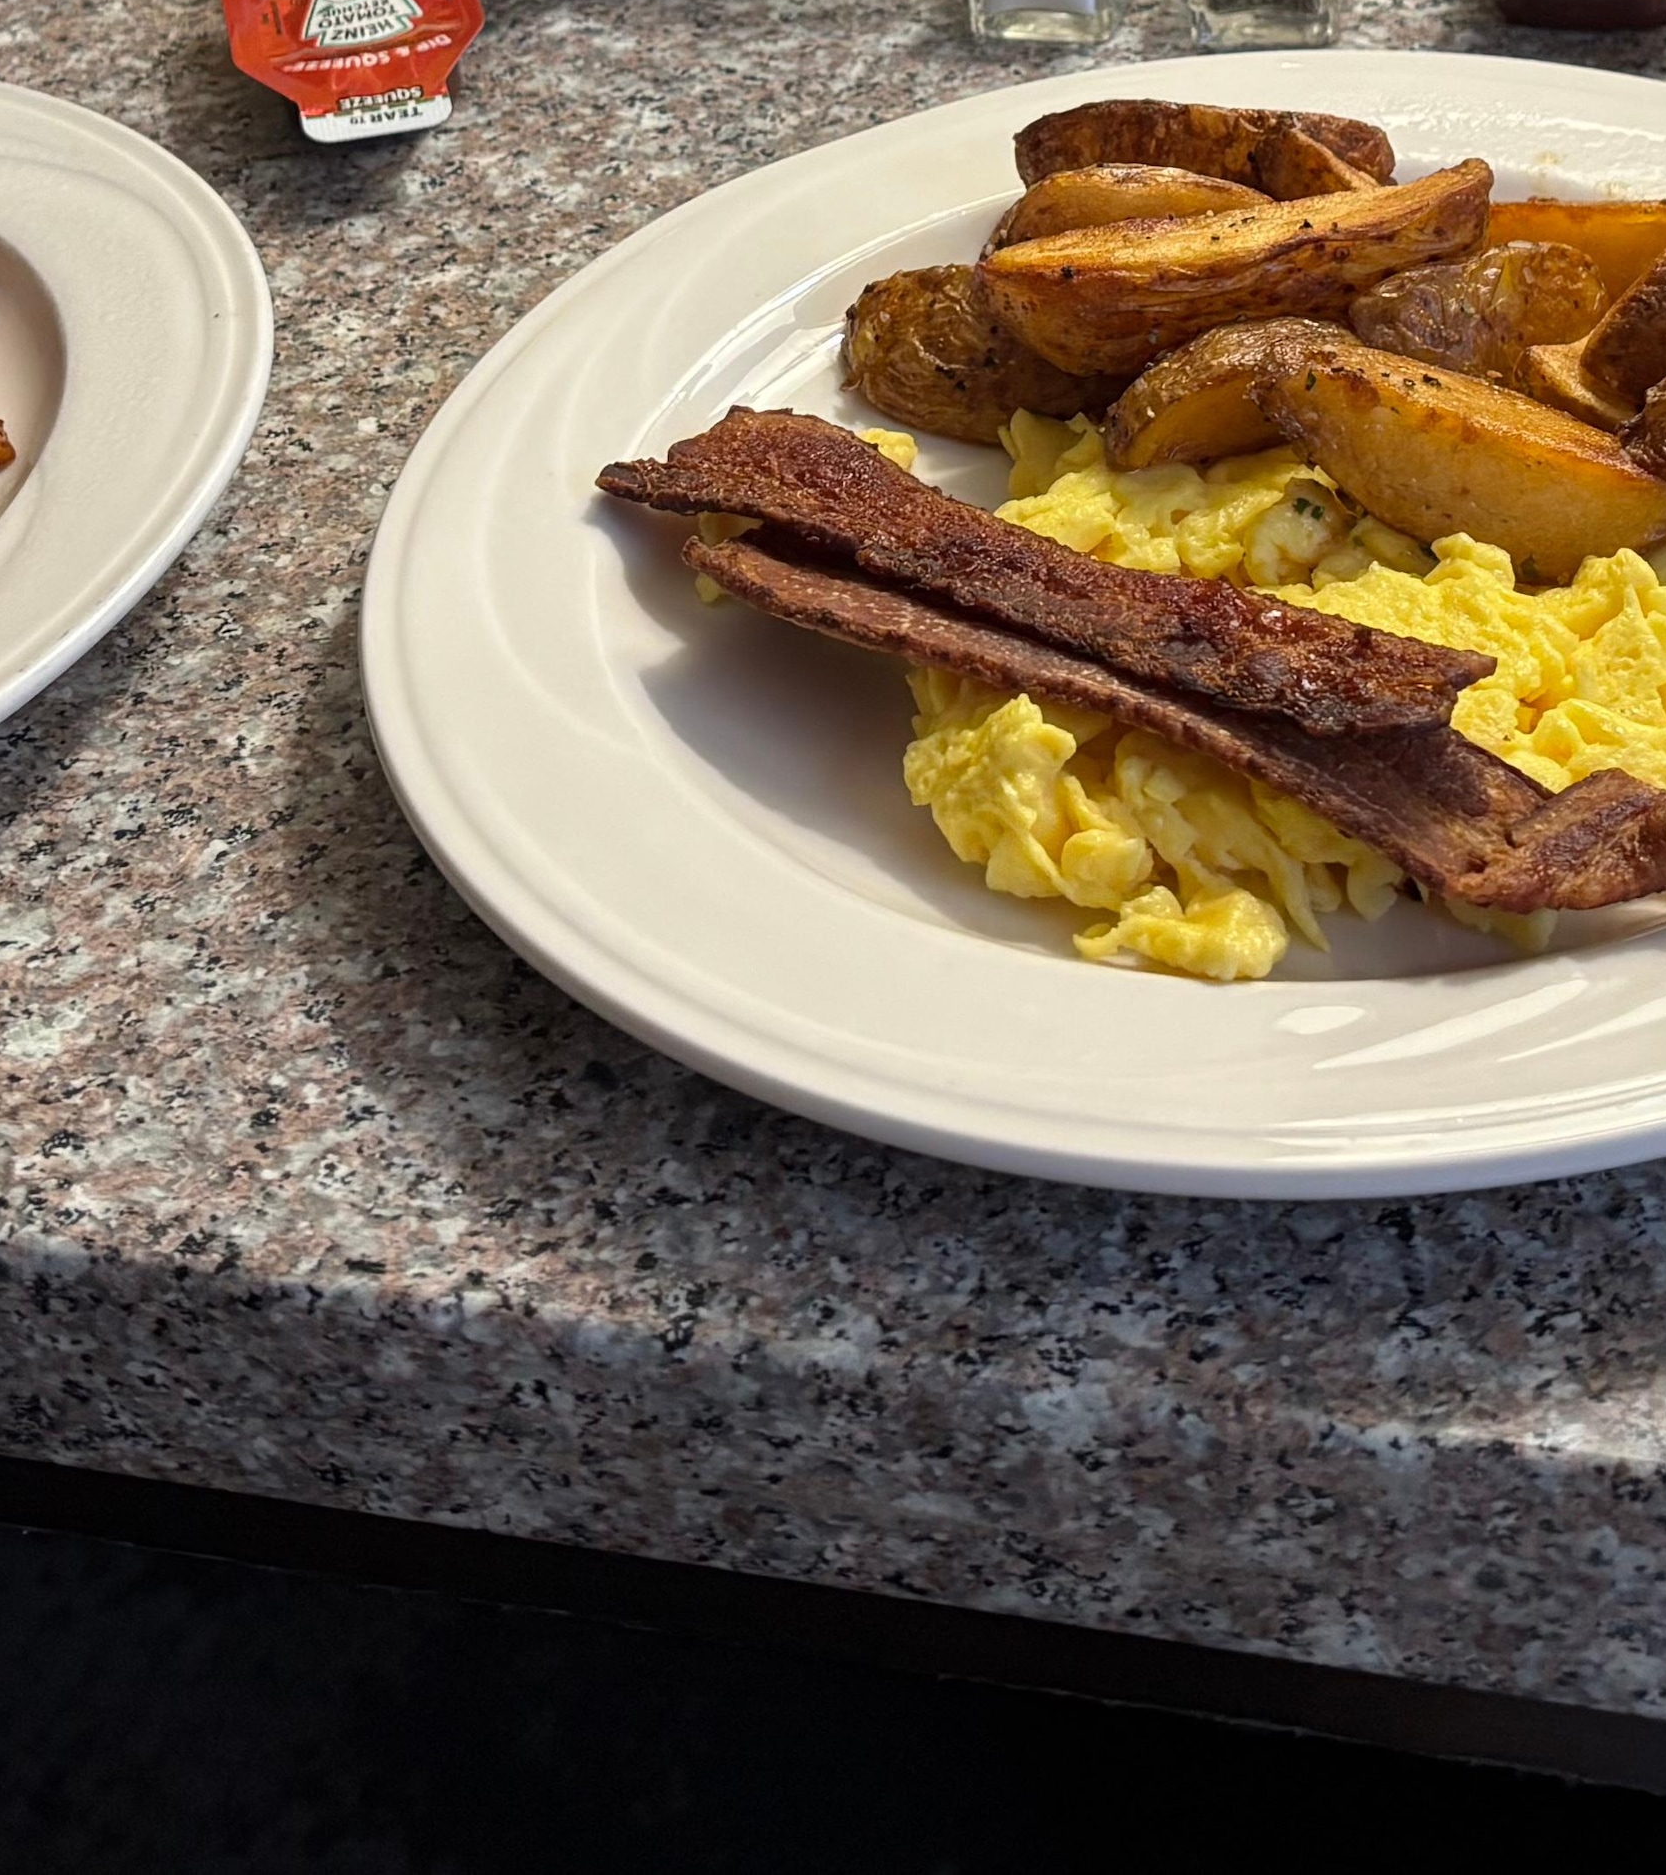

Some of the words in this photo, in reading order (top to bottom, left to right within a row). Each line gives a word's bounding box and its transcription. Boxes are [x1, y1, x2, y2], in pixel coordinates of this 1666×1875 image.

[318, 4, 400, 30] TOMATO
[329, 18, 395, 42] HEINZ
[395, 44, 411, 57] &
[416, 34, 452, 53] DIP
[339, 86, 423, 111] SQUEEZE
[350, 114, 367, 125] TO
[370, 106, 424, 124] TEAR
